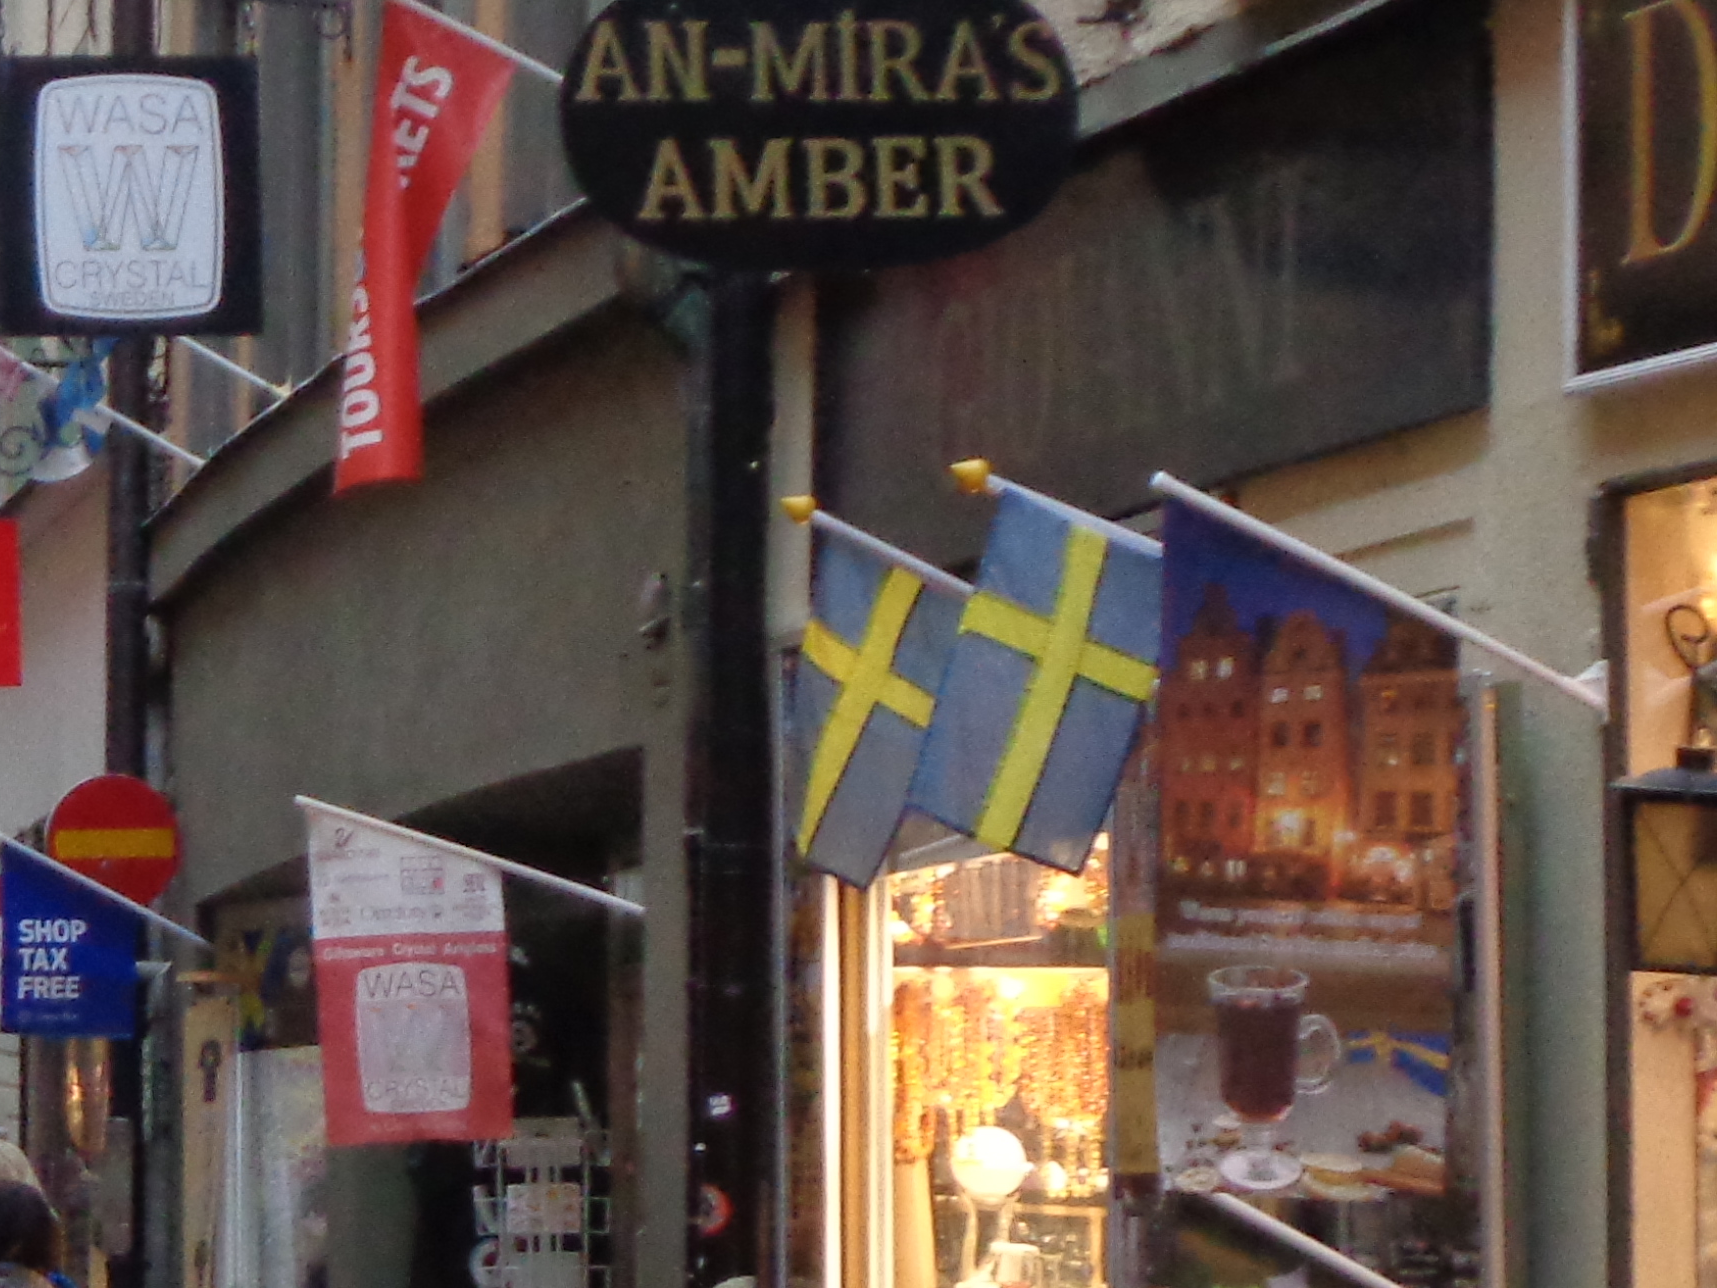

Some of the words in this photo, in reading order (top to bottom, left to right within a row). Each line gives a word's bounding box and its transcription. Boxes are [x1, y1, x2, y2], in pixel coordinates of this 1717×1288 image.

[52, 93, 204, 136] WASA
[638, 135, 1004, 220] AMBER
[54, 260, 214, 290] CRYSTAL
[89, 291, 175, 307] SWEDEN
[18, 918, 87, 943] SHOP
[18, 947, 69, 971] TAX
[17, 976, 81, 1000] FREE
[364, 970, 461, 999] WASA
